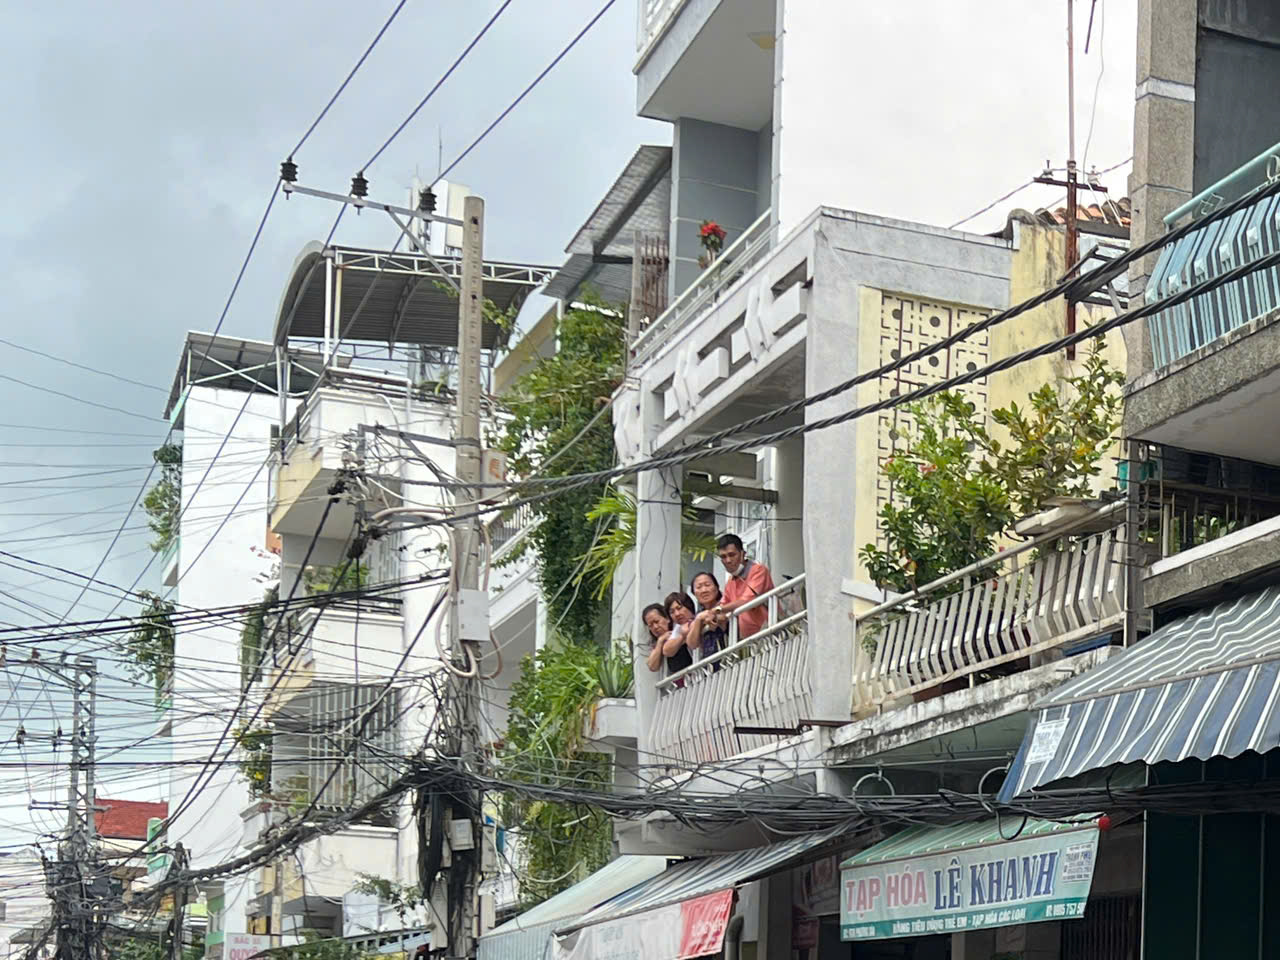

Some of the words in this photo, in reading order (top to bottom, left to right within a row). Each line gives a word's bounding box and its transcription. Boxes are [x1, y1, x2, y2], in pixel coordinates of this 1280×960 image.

[845, 877, 881, 918] TẠP
[886, 864, 927, 907] HÓA
[934, 857, 961, 910] LÊ
[969, 851, 1058, 906] KHANH
